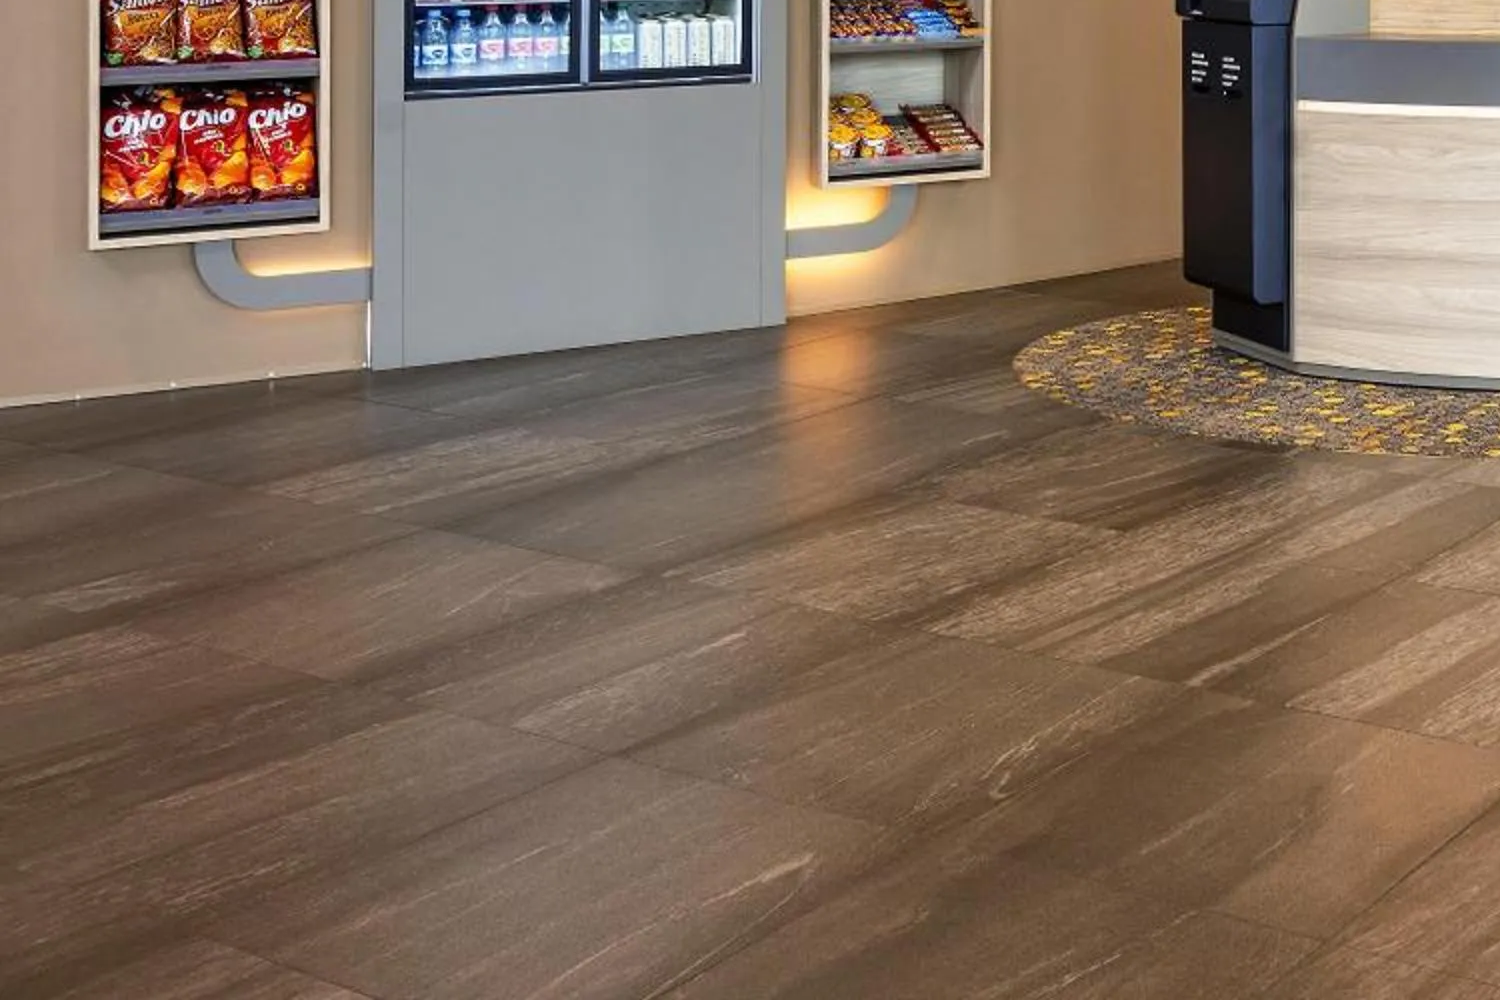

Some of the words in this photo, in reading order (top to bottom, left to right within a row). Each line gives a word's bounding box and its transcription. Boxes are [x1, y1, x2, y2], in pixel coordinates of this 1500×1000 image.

[104, 109, 167, 139] Chio
[179, 107, 238, 132] Chio
[248, 101, 307, 130] Chio
